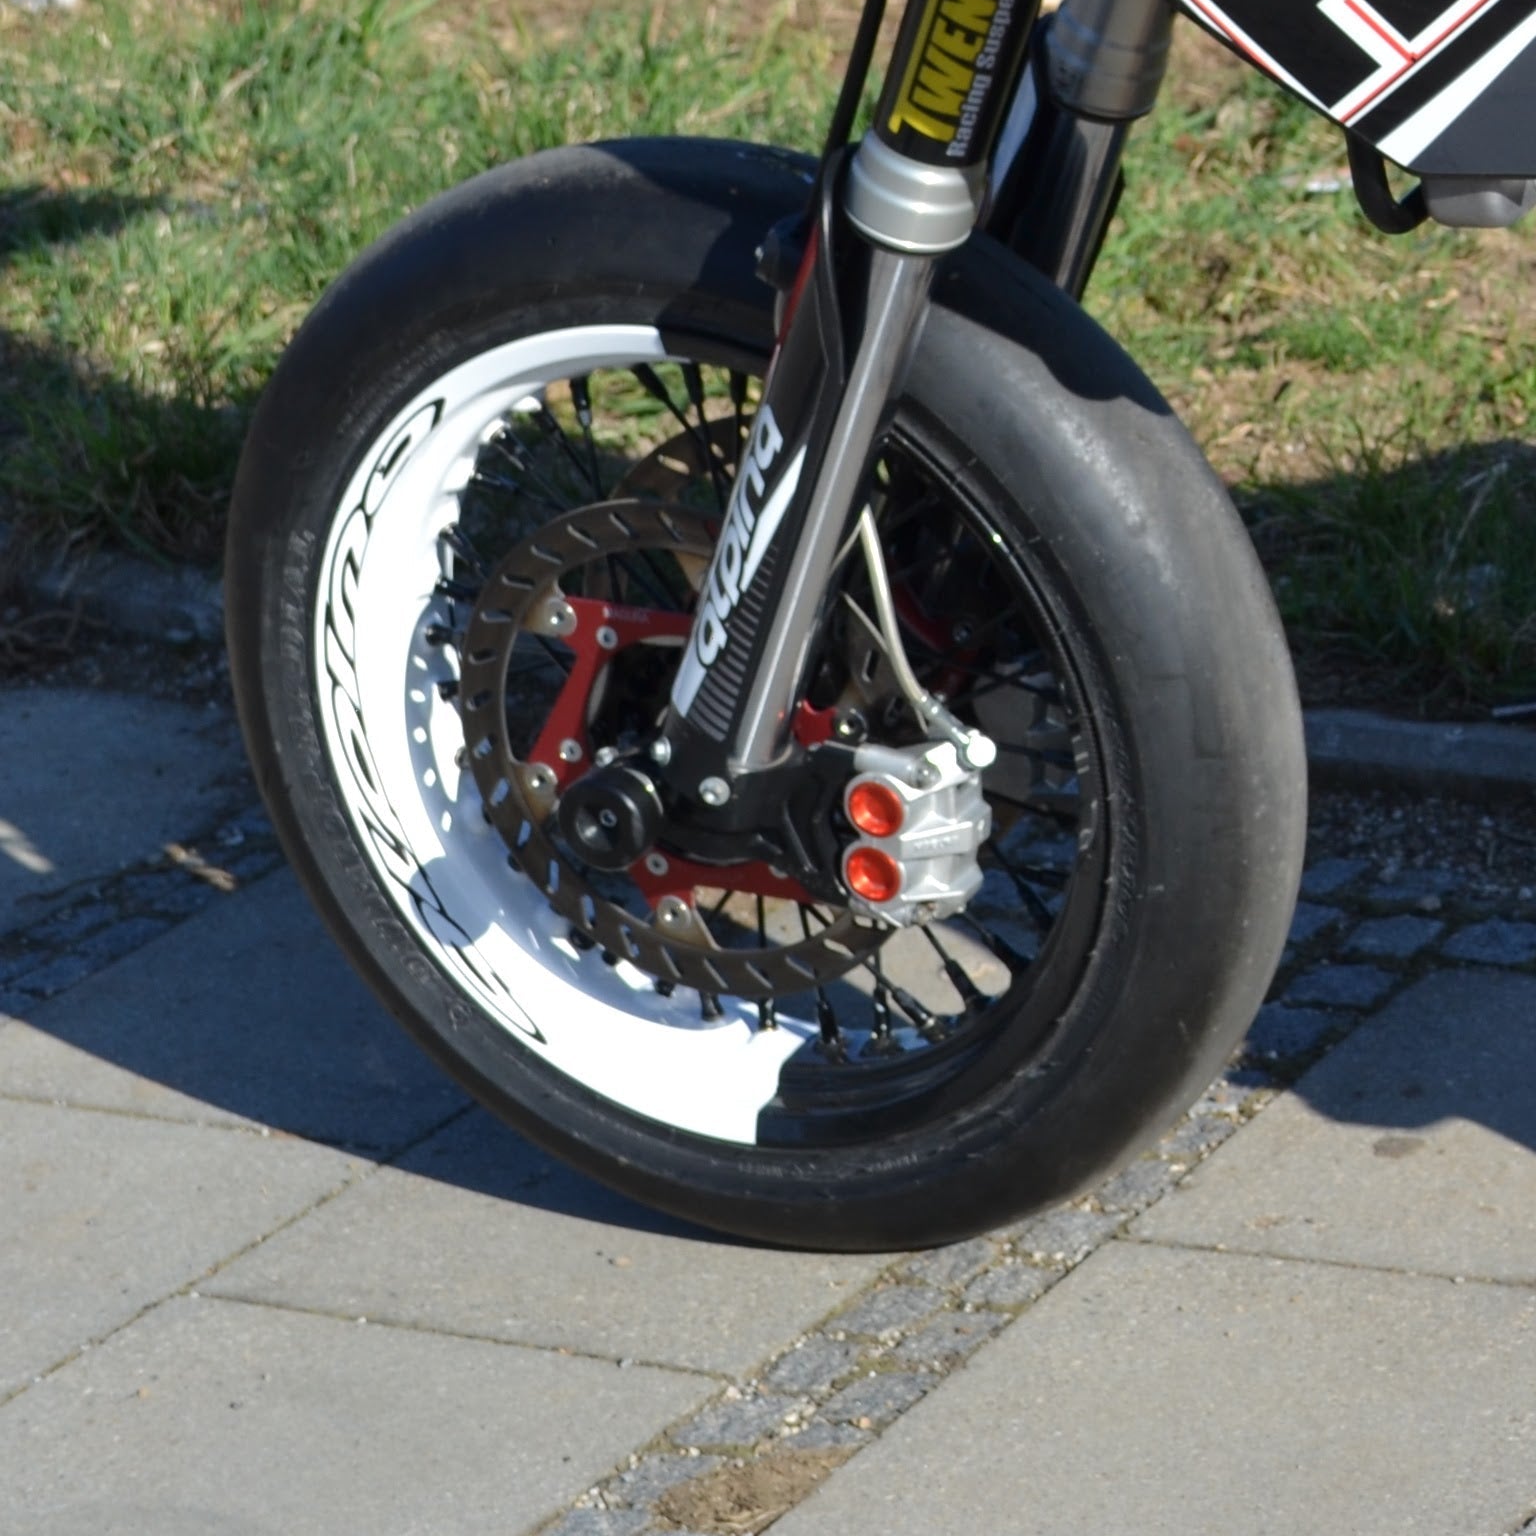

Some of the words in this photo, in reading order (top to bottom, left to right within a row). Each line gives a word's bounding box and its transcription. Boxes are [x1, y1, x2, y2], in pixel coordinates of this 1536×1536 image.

[945, 77, 993, 157] Racing
[698, 404, 783, 665] alpina
[320, 397, 548, 1045] alpina
